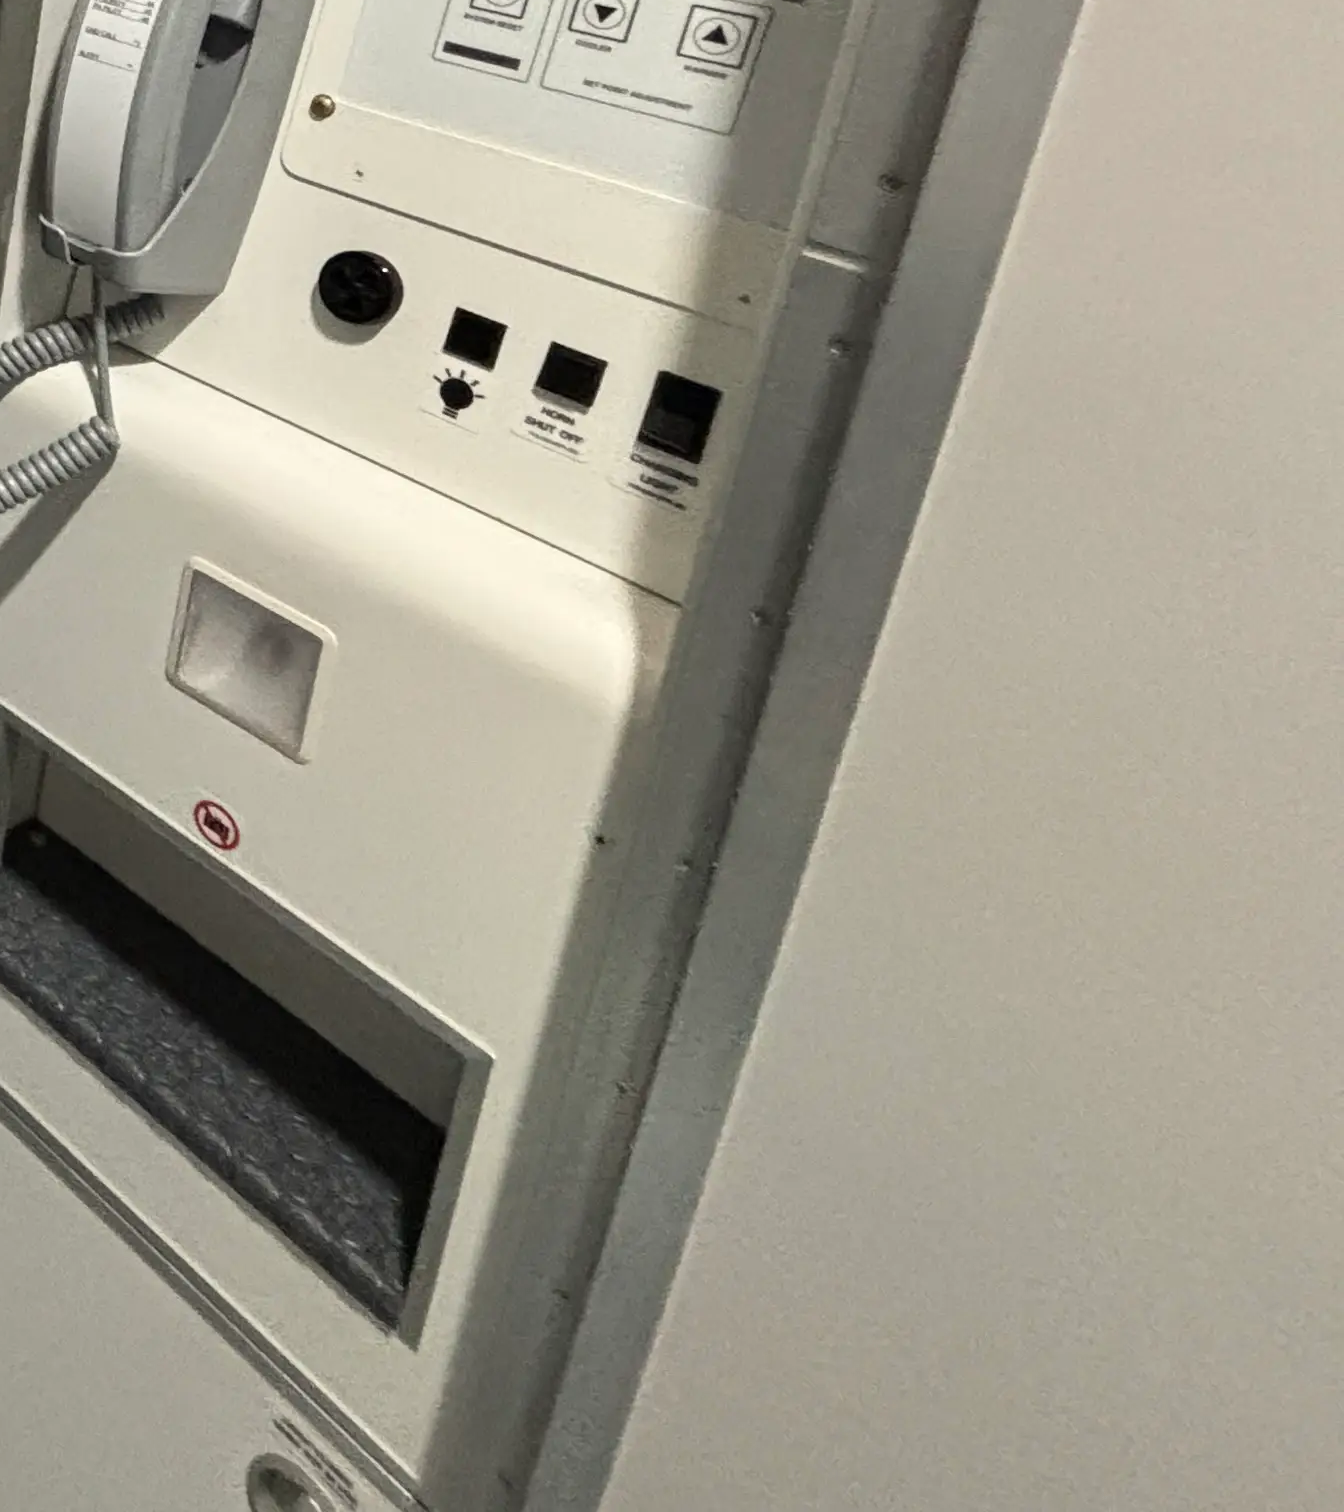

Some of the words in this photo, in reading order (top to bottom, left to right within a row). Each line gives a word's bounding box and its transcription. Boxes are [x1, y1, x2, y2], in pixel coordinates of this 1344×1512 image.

[540, 406, 576, 426] HORN
[523, 415, 555, 434] SHUT
[558, 428, 585, 445] OFF
